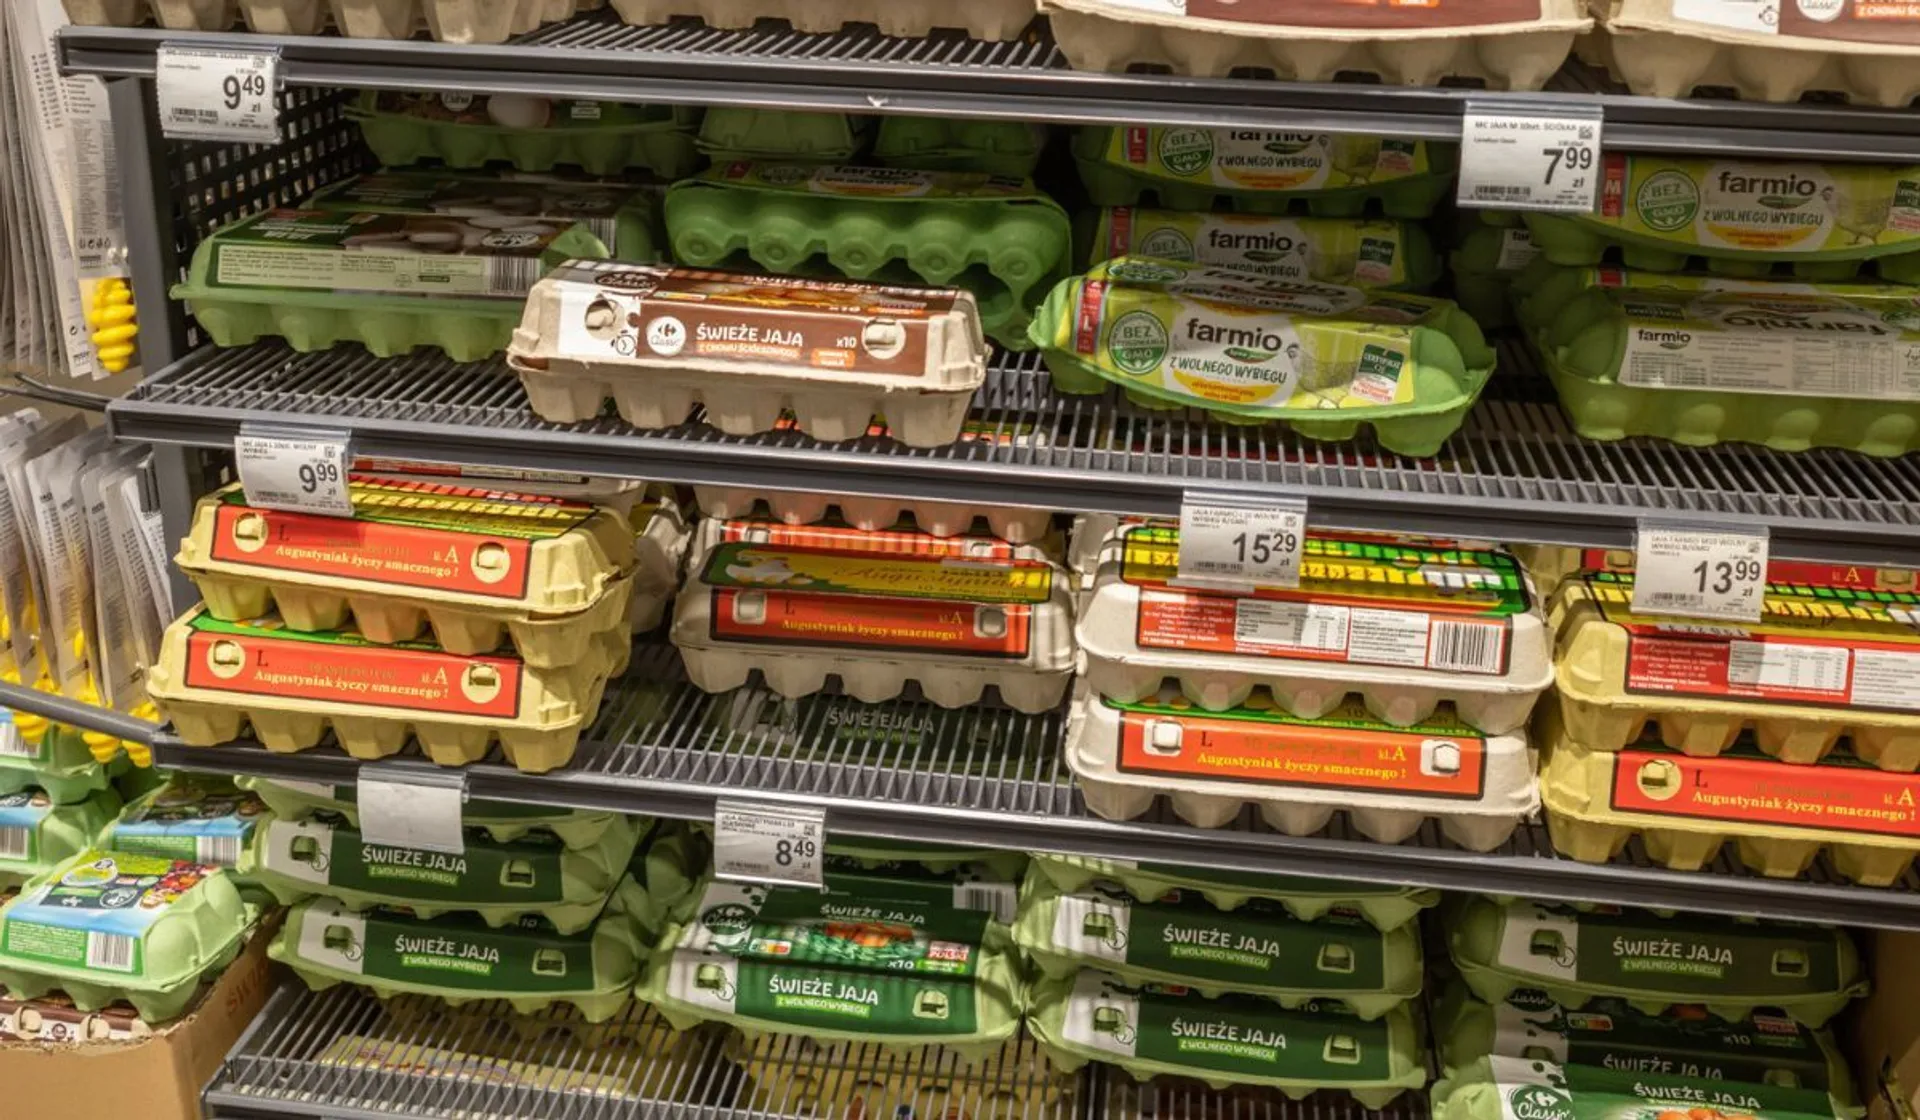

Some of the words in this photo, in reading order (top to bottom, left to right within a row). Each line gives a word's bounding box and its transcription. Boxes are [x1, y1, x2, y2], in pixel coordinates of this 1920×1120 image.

[1172, 134, 1196, 145] BEZ
[1225, 156, 1274, 168] WOLNEGO
[1276, 157, 1322, 169] WYBIEGU
[1605, 180, 1621, 196] M
[1652, 184, 1683, 198] BEZ
[1719, 172, 1816, 197] farmio
[1703, 210, 1711, 221] Z
[1712, 211, 1768, 224] WOLNEGO
[1770, 212, 1824, 227] WYBIEGU
[1209, 229, 1292, 251] farmio
[1253, 264, 1300, 278] WYBIEGU
[1083, 315, 1093, 332] L
[696, 323, 759, 343] ŚWIEŻE
[760, 330, 804, 347] JAJA
[1123, 326, 1152, 341] BEZ
[1186, 318, 1282, 351] farmio
[1638, 329, 1691, 344] farmio
[836, 337, 858, 349] x10
[1169, 357, 1178, 369] Z
[1179, 360, 1234, 377] WOLNEGO
[1235, 365, 1289, 385] WYBIEGU
[278, 525, 290, 541] L
[275, 546, 349, 564] Augustyniak
[351, 556, 383, 571] życzy
[384, 561, 452, 578] smacznego
[444, 546, 459, 563] A
[1844, 567, 1861, 583] A
[784, 601, 795, 615] L
[950, 612, 963, 625] A
[782, 620, 855, 634] Augustyniak
[857, 625, 888, 637] życzy
[890, 628, 957, 641] smacznego
[256, 651, 269, 668] L
[254, 670, 333, 689] Augustyniak
[335, 679, 370, 693] życzy
[371, 683, 441, 699] smacznego
[433, 667, 449, 685] A
[1201, 732, 1213, 748] L
[1391, 746, 1406, 762] A
[1197, 753, 1282, 770] Augustyniak
[1284, 761, 1321, 774] życzy
[1322, 765, 1398, 781] smacznego
[1694, 770, 1709, 788] L
[1898, 787, 1915, 807] A
[1692, 791, 1782, 810] Augustyniak
[1784, 801, 1824, 814] życzy
[1826, 805, 1906, 823] smacznego
[362, 845, 424, 867] ŚWIEŻE
[425, 855, 467, 875] JAJA
[377, 867, 417, 877] WOLNEGO
[418, 870, 457, 883] WYBIEGU
[820, 903, 882, 918] ŚWIEŻE
[883, 911, 925, 925] JAJA
[395, 934, 456, 957] ŚWIEŻE
[457, 944, 500, 964] JAJA
[1163, 923, 1231, 948] ŚWIEŻE
[1233, 935, 1281, 958] JAJA
[1180, 948, 1226, 961] WOLNEGO
[1227, 952, 1269, 969] WYBIEGU
[1613, 936, 1683, 958] ŚWIEŻE
[1684, 944, 1734, 966] JAJA
[410, 956, 450, 967] WOLNEGO
[451, 960, 490, 974] WYBIEGU
[887, 959, 914, 970] x10
[1631, 960, 1677, 973] WOLNEGO
[1678, 964, 1722, 978] WYBIEGU
[769, 975, 833, 996] ŚWIEŻE
[832, 985, 880, 1006] JAJA
[778, 998, 785, 1007] Z
[786, 999, 827, 1010] WOLNEGO
[828, 1003, 868, 1015] WYBIEGU
[1171, 1017, 1239, 1042] ŚWIEŻE
[1241, 1027, 1287, 1050] JAJA
[1180, 1041, 1187, 1050] Z
[1188, 1041, 1233, 1054] WOLNEGO
[1233, 1046, 1276, 1061] WYBIEGU
[1603, 1053, 1673, 1072] ŚWIEŻE
[1633, 1081, 1705, 1102] ŚWIEŻE
[1710, 1089, 1762, 1110] JAJA
